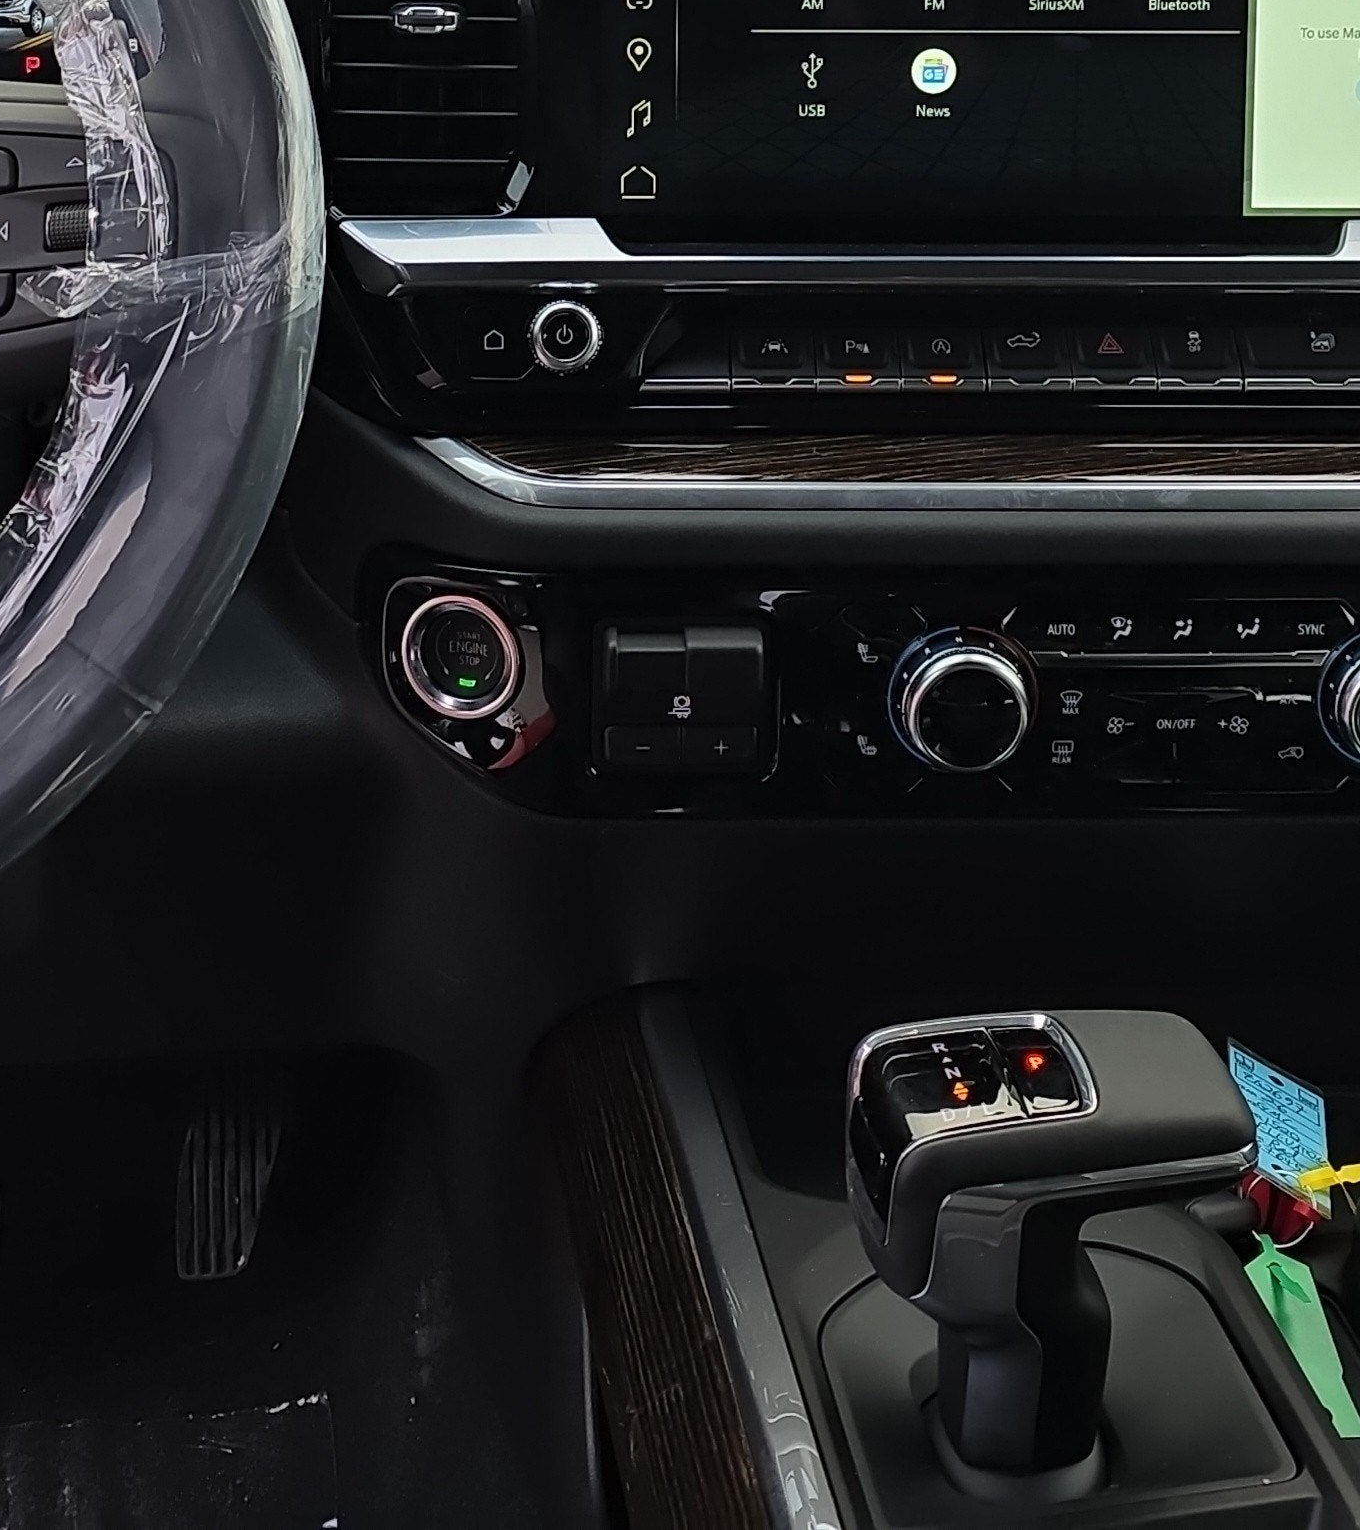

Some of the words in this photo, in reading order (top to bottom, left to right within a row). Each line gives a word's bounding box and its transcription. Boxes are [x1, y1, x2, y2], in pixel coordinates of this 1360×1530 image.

[1301, 28, 1315, 40] To
[1317, 31, 1340, 40] use
[27, 56, 40, 73] P
[799, 103, 826, 117] USB
[916, 104, 951, 117] News
[1047, 623, 1076, 636] AUTO
[1297, 623, 1326, 636] SYNC
[449, 640, 488, 658] ENGINE
[459, 655, 481, 666] STOP
[1156, 719, 1196, 730] ON/OFF
[1052, 756, 1072, 764] REAR
[931, 1043, 949, 1053] R
[944, 1067, 962, 1080] N
[941, 1108, 955, 1122] D
